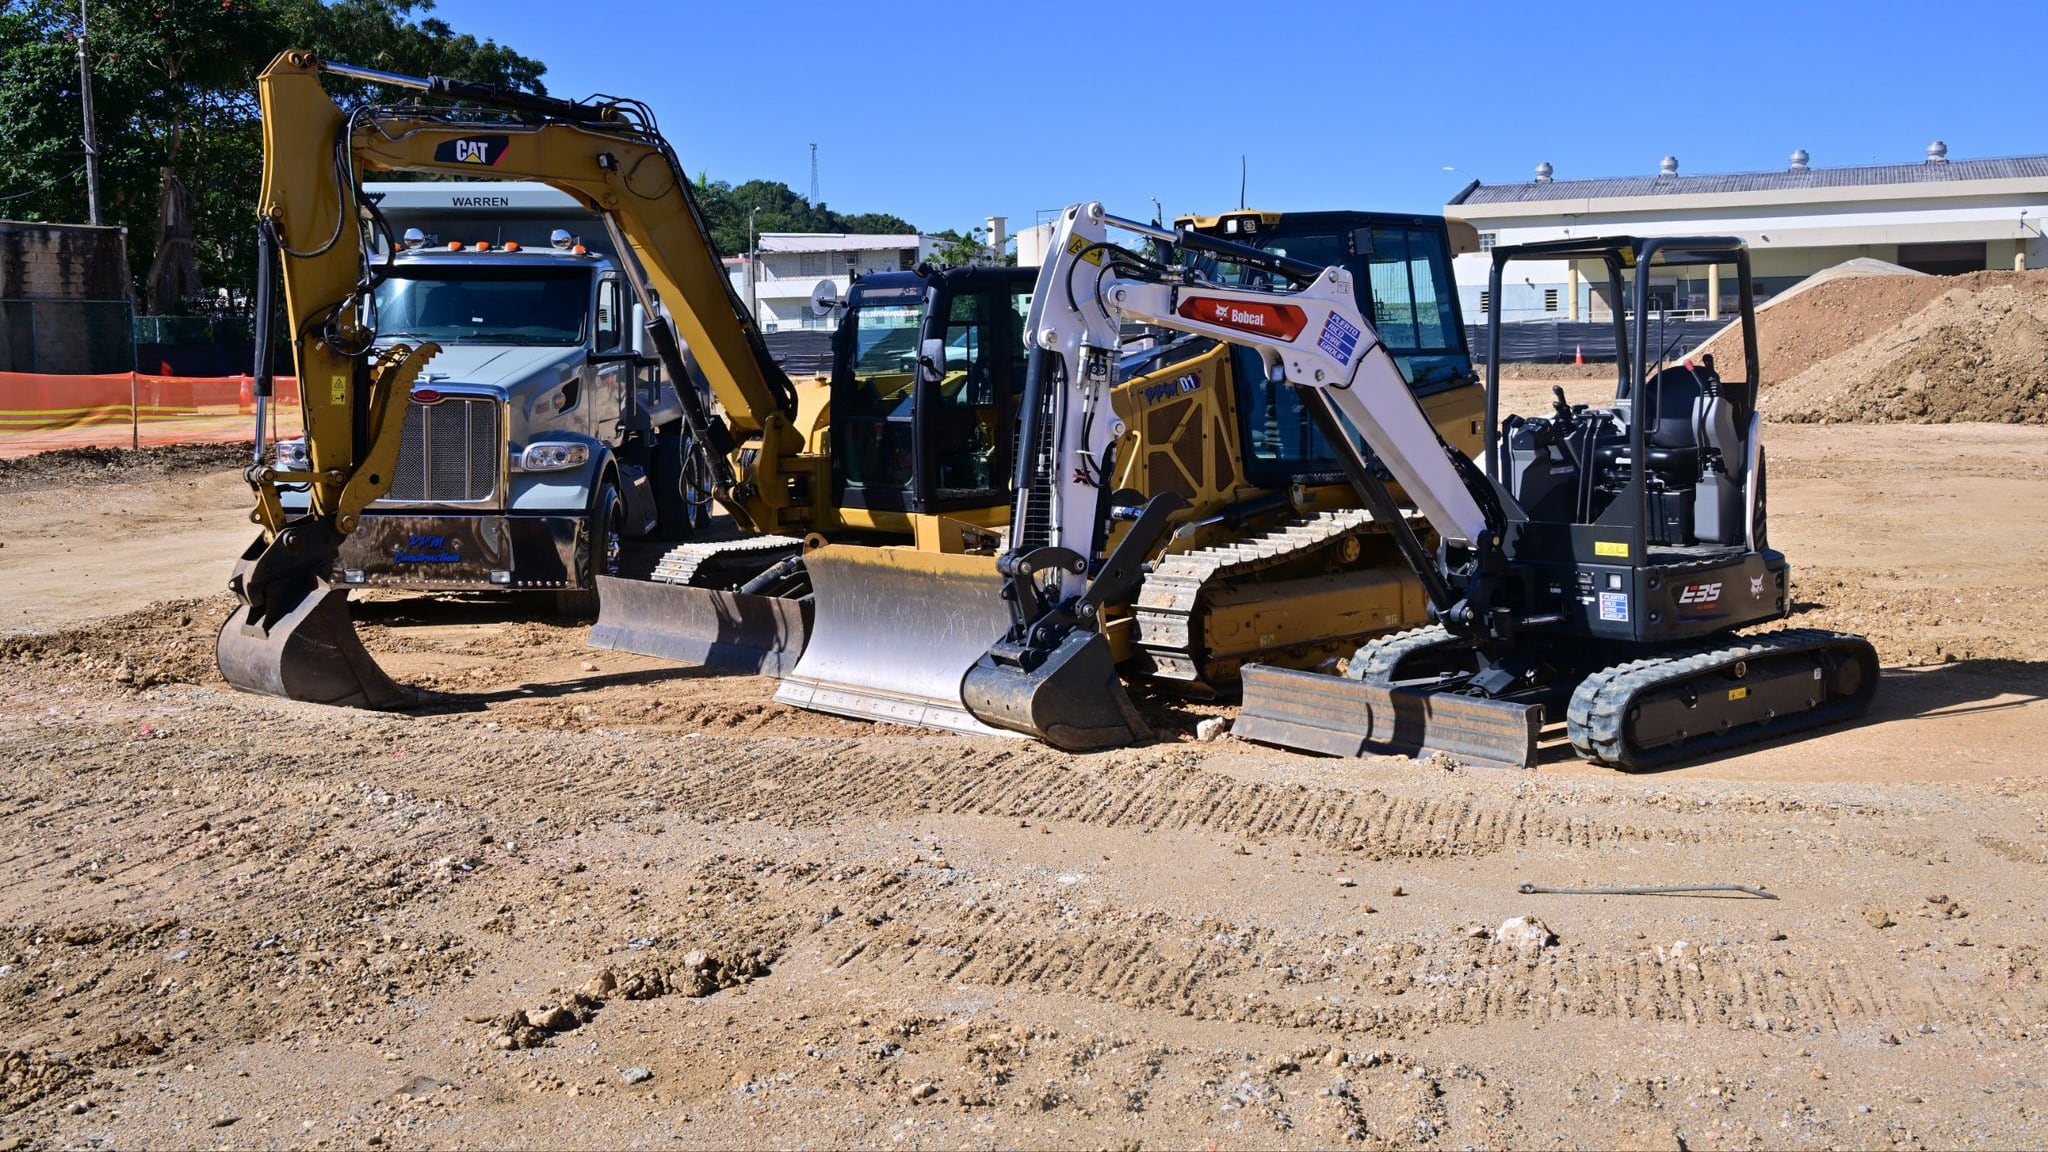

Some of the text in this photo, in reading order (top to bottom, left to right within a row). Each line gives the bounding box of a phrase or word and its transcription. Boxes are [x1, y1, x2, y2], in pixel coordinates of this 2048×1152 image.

[456, 140, 488, 163] CAT
[452, 197, 509, 206] WARREN
[1231, 309, 1265, 326] Bobcat
[1331, 314, 1359, 336] PUERTO
[1323, 331, 1342, 347] WIRE
[1327, 323, 1345, 338] RICO
[1320, 341, 1345, 360] GROUP
[1179, 375, 1196, 392] D1
[1679, 582, 1722, 604] E35
